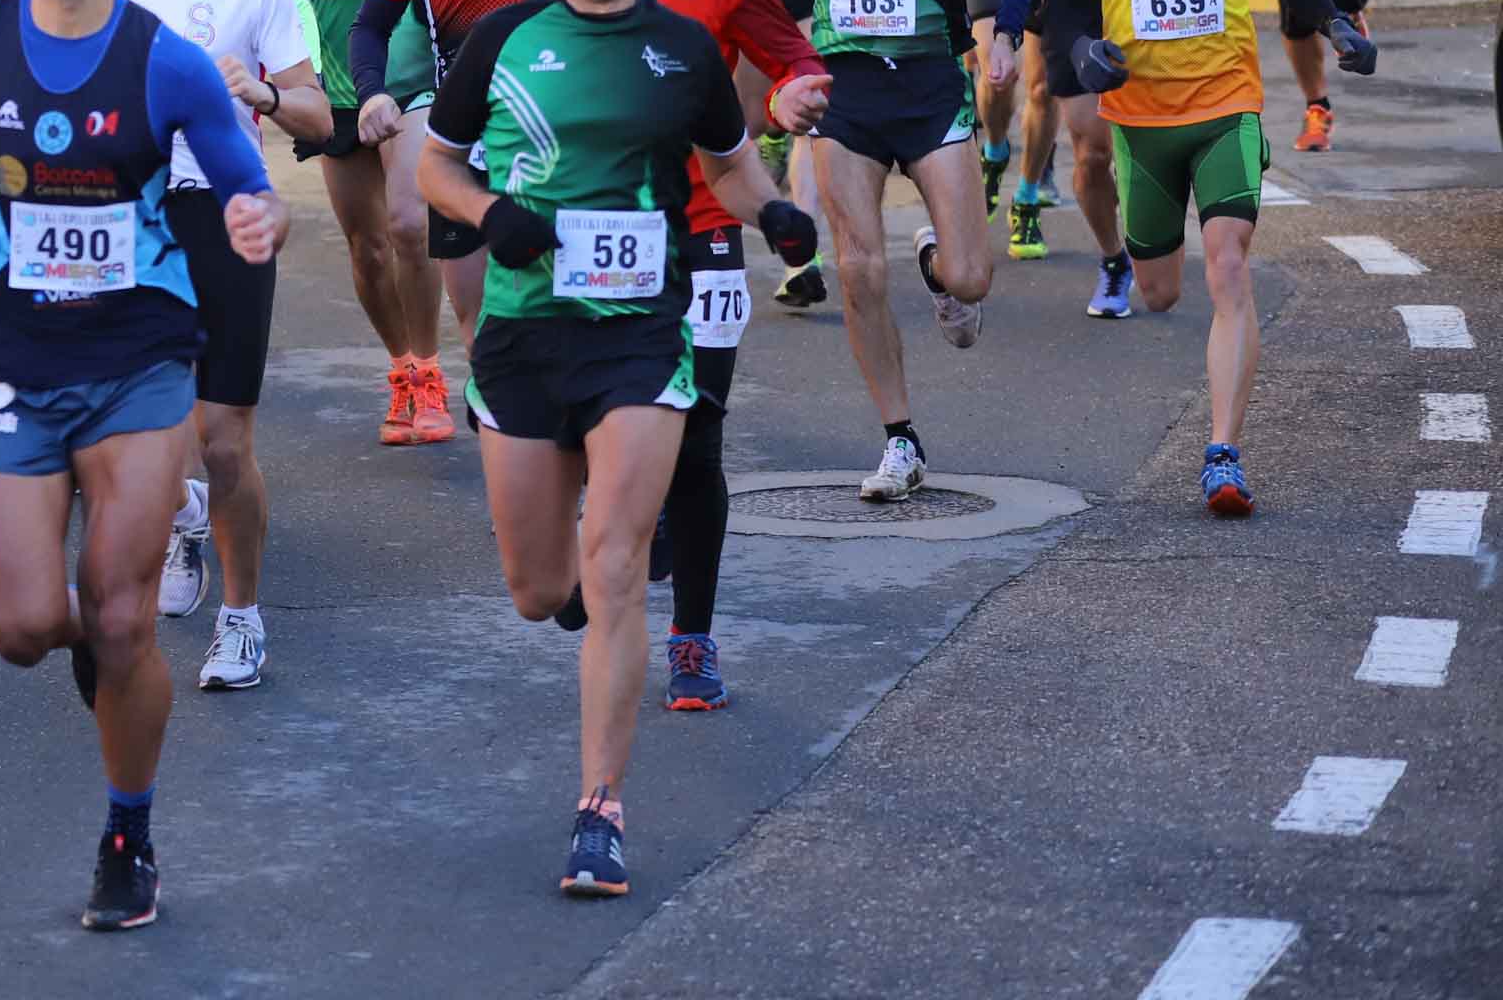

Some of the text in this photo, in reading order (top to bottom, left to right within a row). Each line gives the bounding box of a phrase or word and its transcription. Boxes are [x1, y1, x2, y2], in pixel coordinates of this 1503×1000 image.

[37, 228, 111, 262] 490
[593, 234, 638, 270] 58
[698, 289, 743, 322] 170
